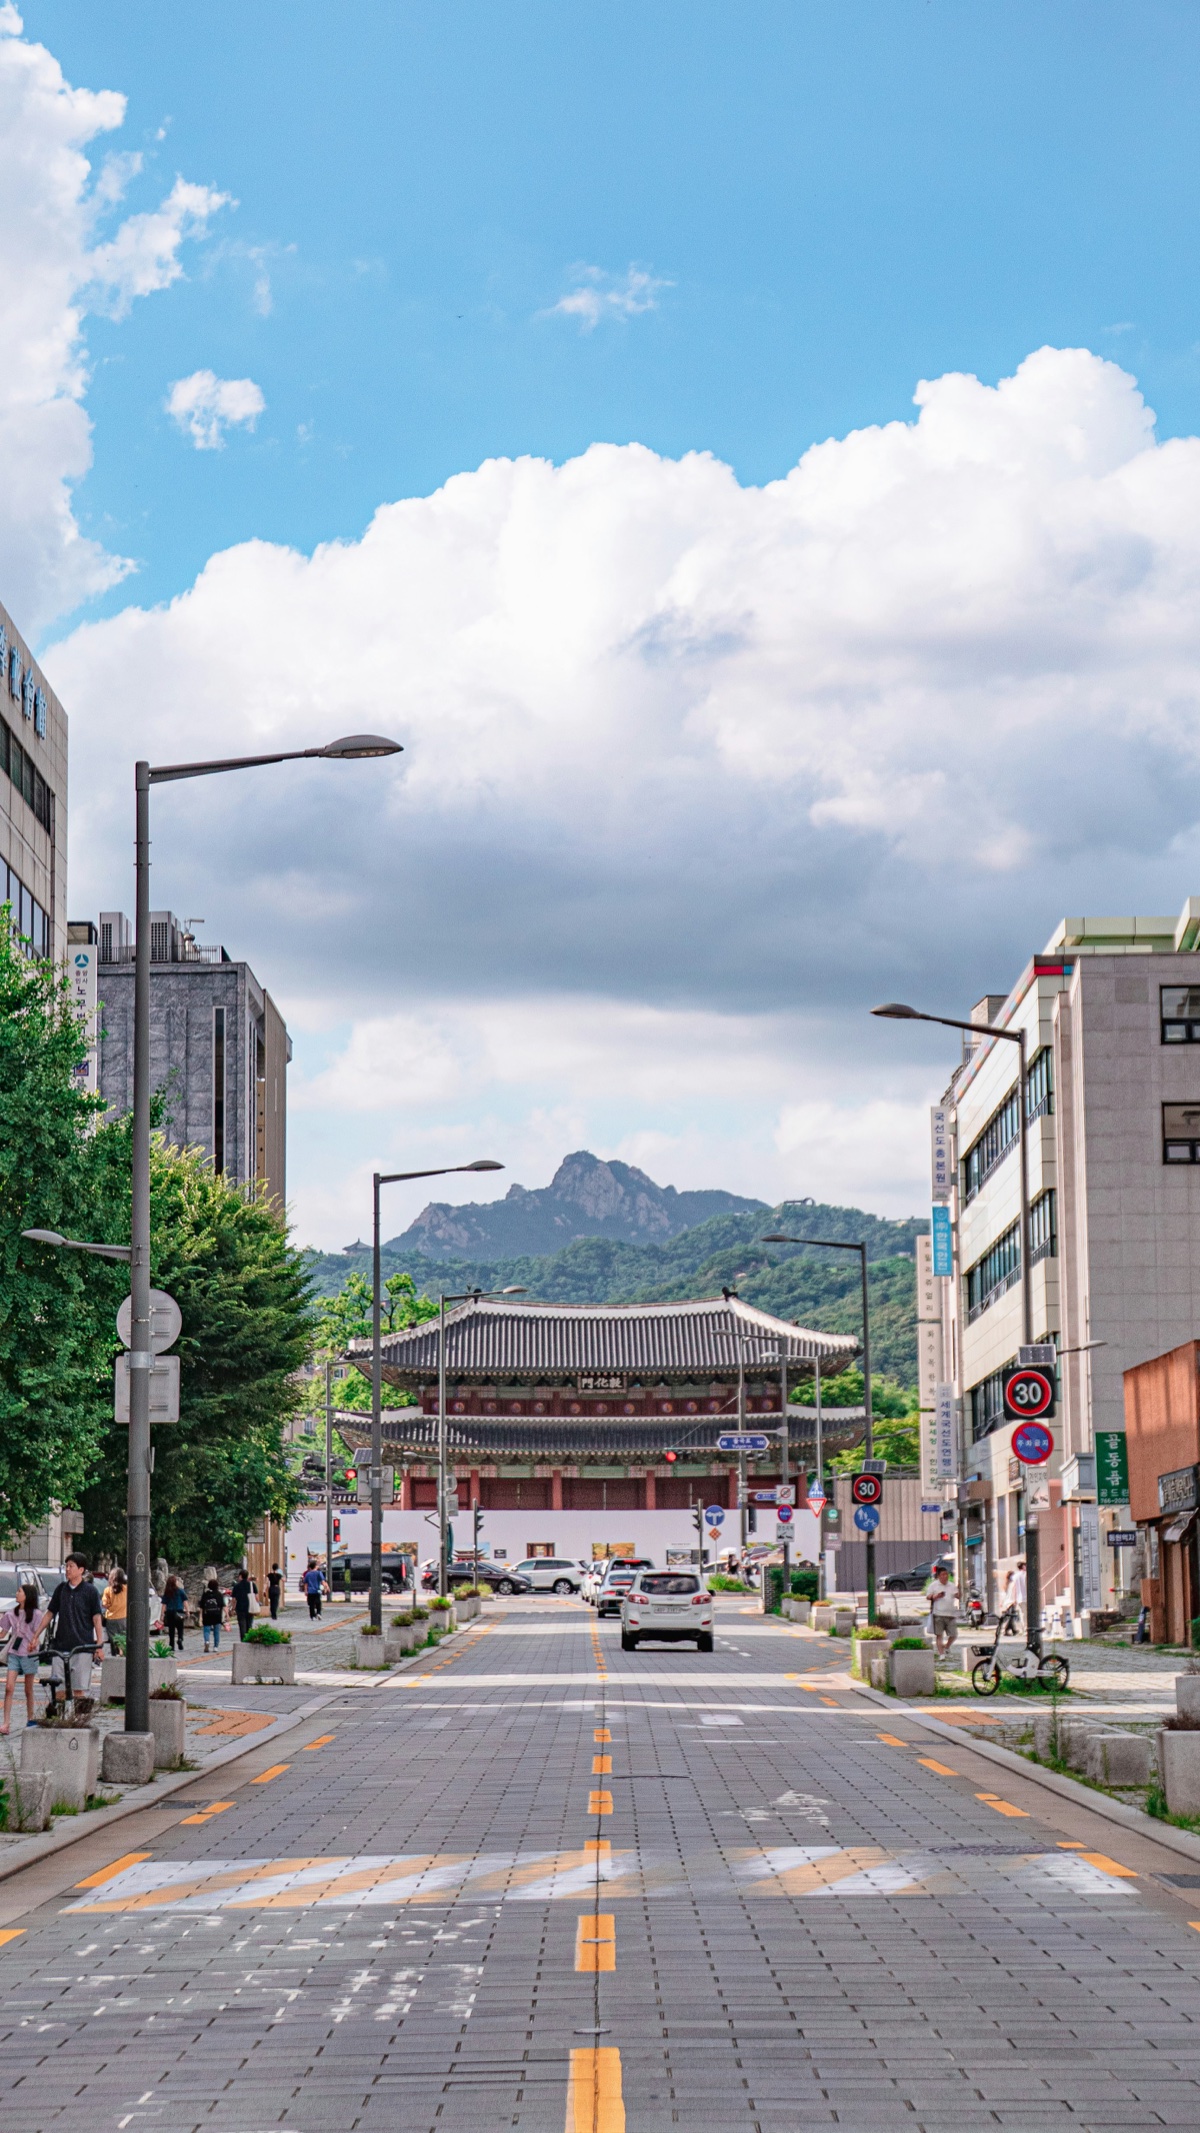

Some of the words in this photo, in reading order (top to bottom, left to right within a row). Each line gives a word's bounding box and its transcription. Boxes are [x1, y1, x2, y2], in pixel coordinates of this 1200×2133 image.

[1015, 1382, 1042, 1404] 30
[1017, 1438, 1049, 1447] 주차금지
[1104, 1433, 1122, 1486] 골동품
[1029, 1472, 1048, 1484] 견인지역
[859, 1482, 876, 1496] 30
